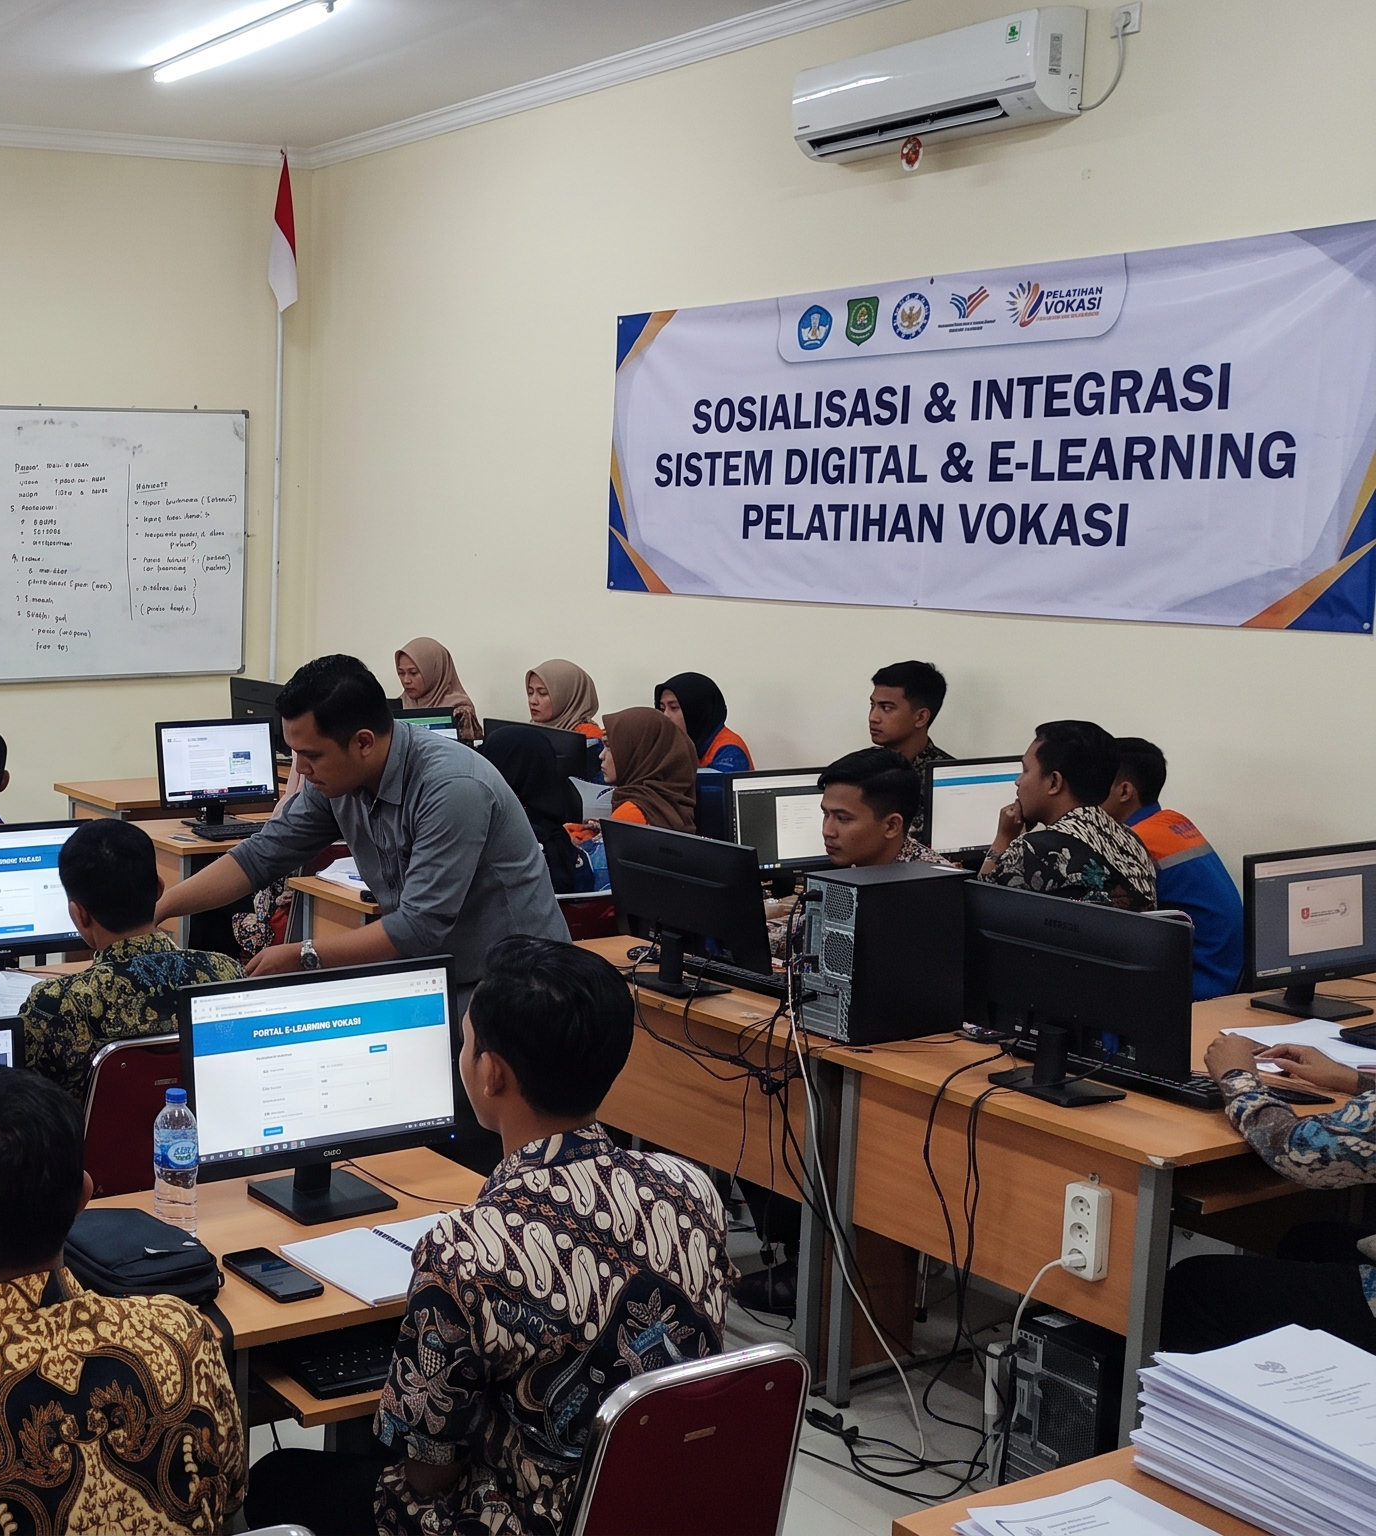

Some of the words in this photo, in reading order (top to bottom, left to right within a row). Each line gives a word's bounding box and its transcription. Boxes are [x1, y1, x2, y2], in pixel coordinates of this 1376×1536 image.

[1044, 297, 1102, 314] VOKASI
[1045, 286, 1103, 300] PELATIHAN
[693, 384, 911, 434] SOSIALISASI
[923, 382, 957, 424] &
[971, 363, 1231, 420] INTEGRASI
[655, 450, 772, 488] SISTEM
[784, 444, 928, 485] DIGITAL
[940, 441, 974, 483] &
[988, 431, 1297, 482] E-LEARNING
[742, 503, 945, 544] PELATIHAN
[959, 502, 1129, 547] VOKASI
[253, 1027, 284, 1038] PORTAL
[284, 1020, 331, 1034] E-LEARNING
